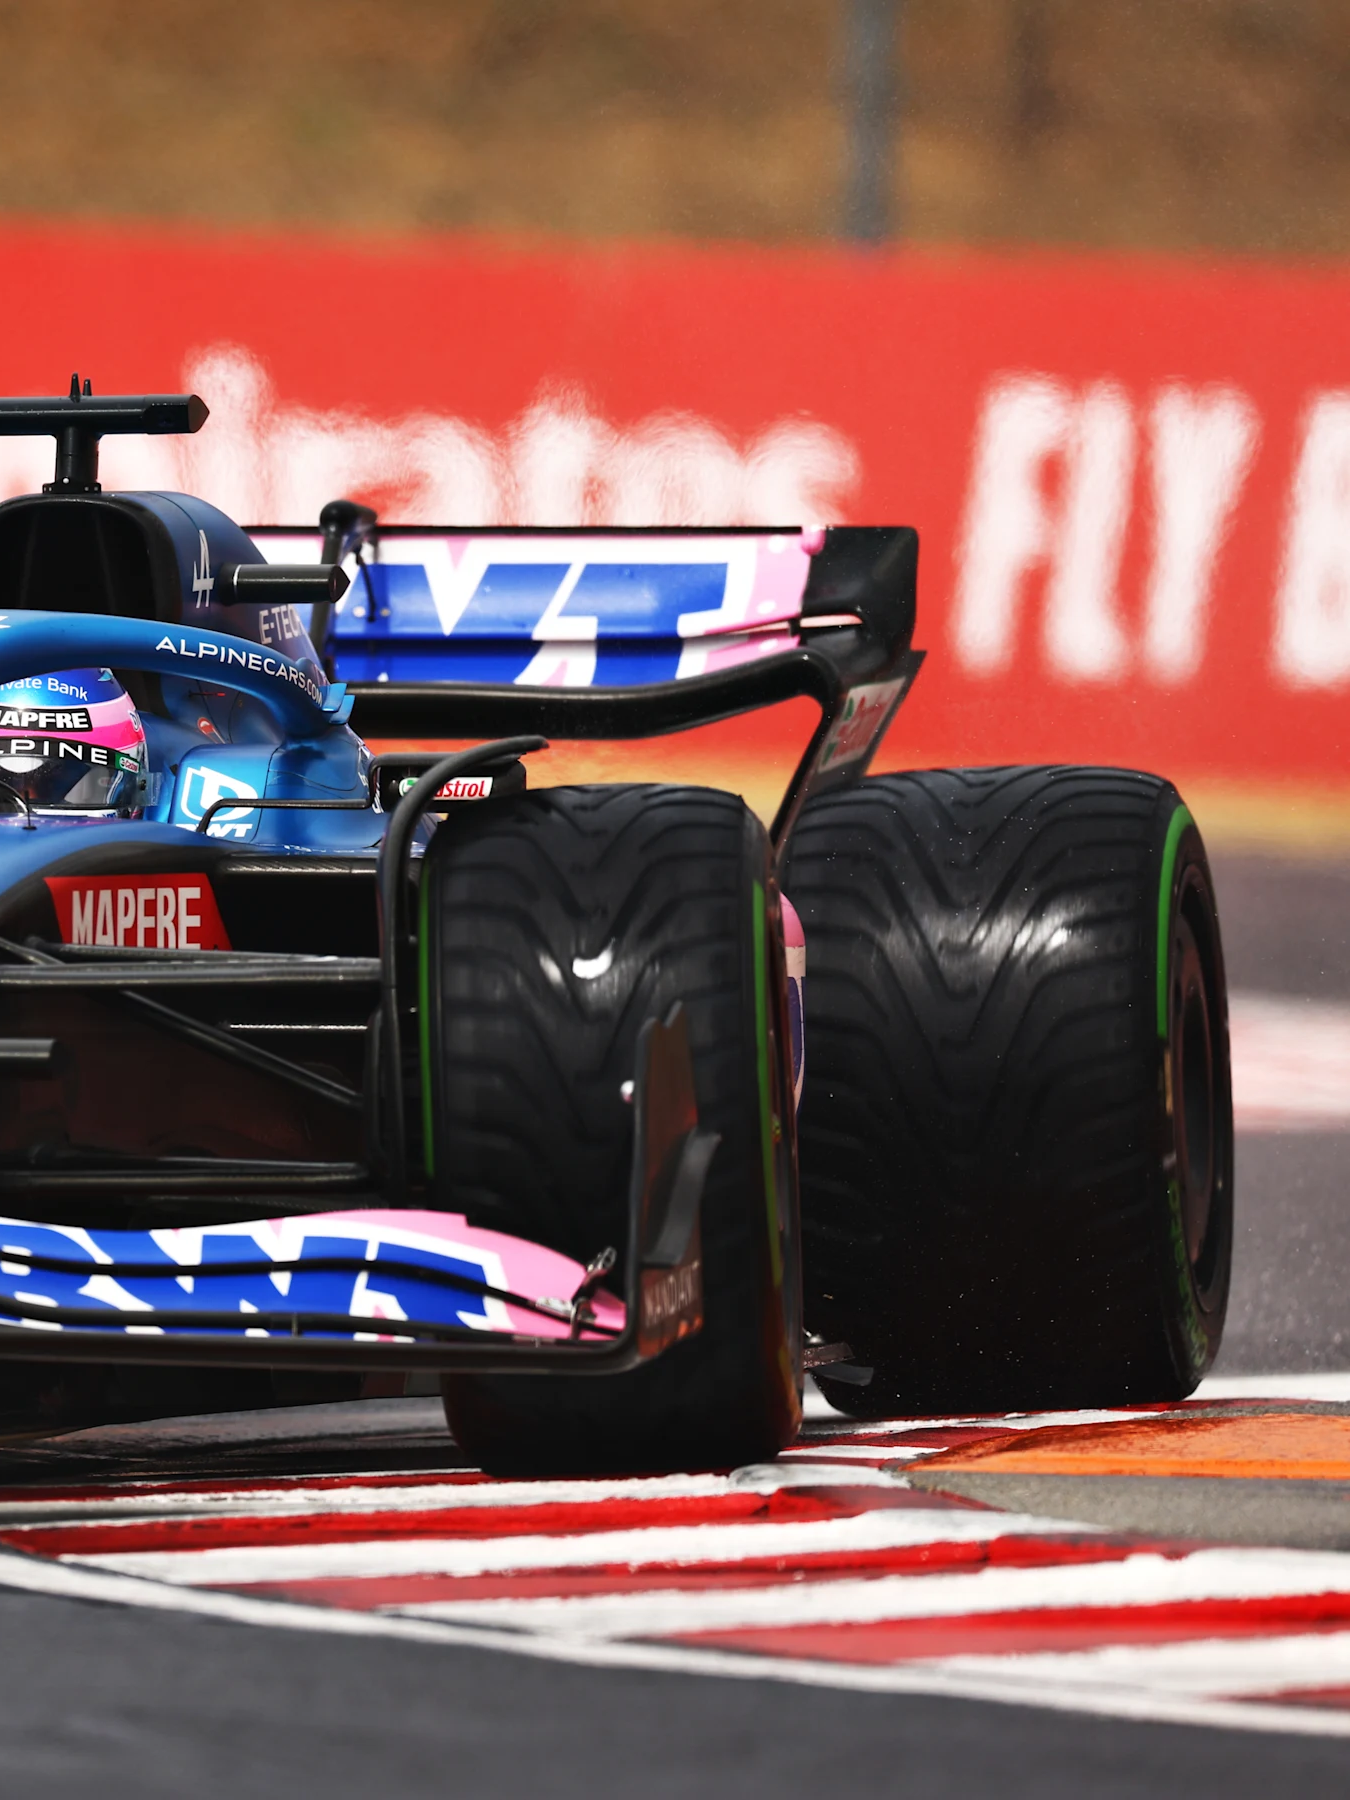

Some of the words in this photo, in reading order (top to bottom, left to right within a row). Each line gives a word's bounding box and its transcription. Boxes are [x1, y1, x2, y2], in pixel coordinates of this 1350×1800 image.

[952, 370, 1262, 684] FLY
[259, 603, 303, 645] E-TEC
[47, 677, 88, 702] Bank
[155, 636, 324, 706] ALPINECARS.COM
[434, 779, 485, 798] astrol
[72, 886, 201, 950] MAPFRE
